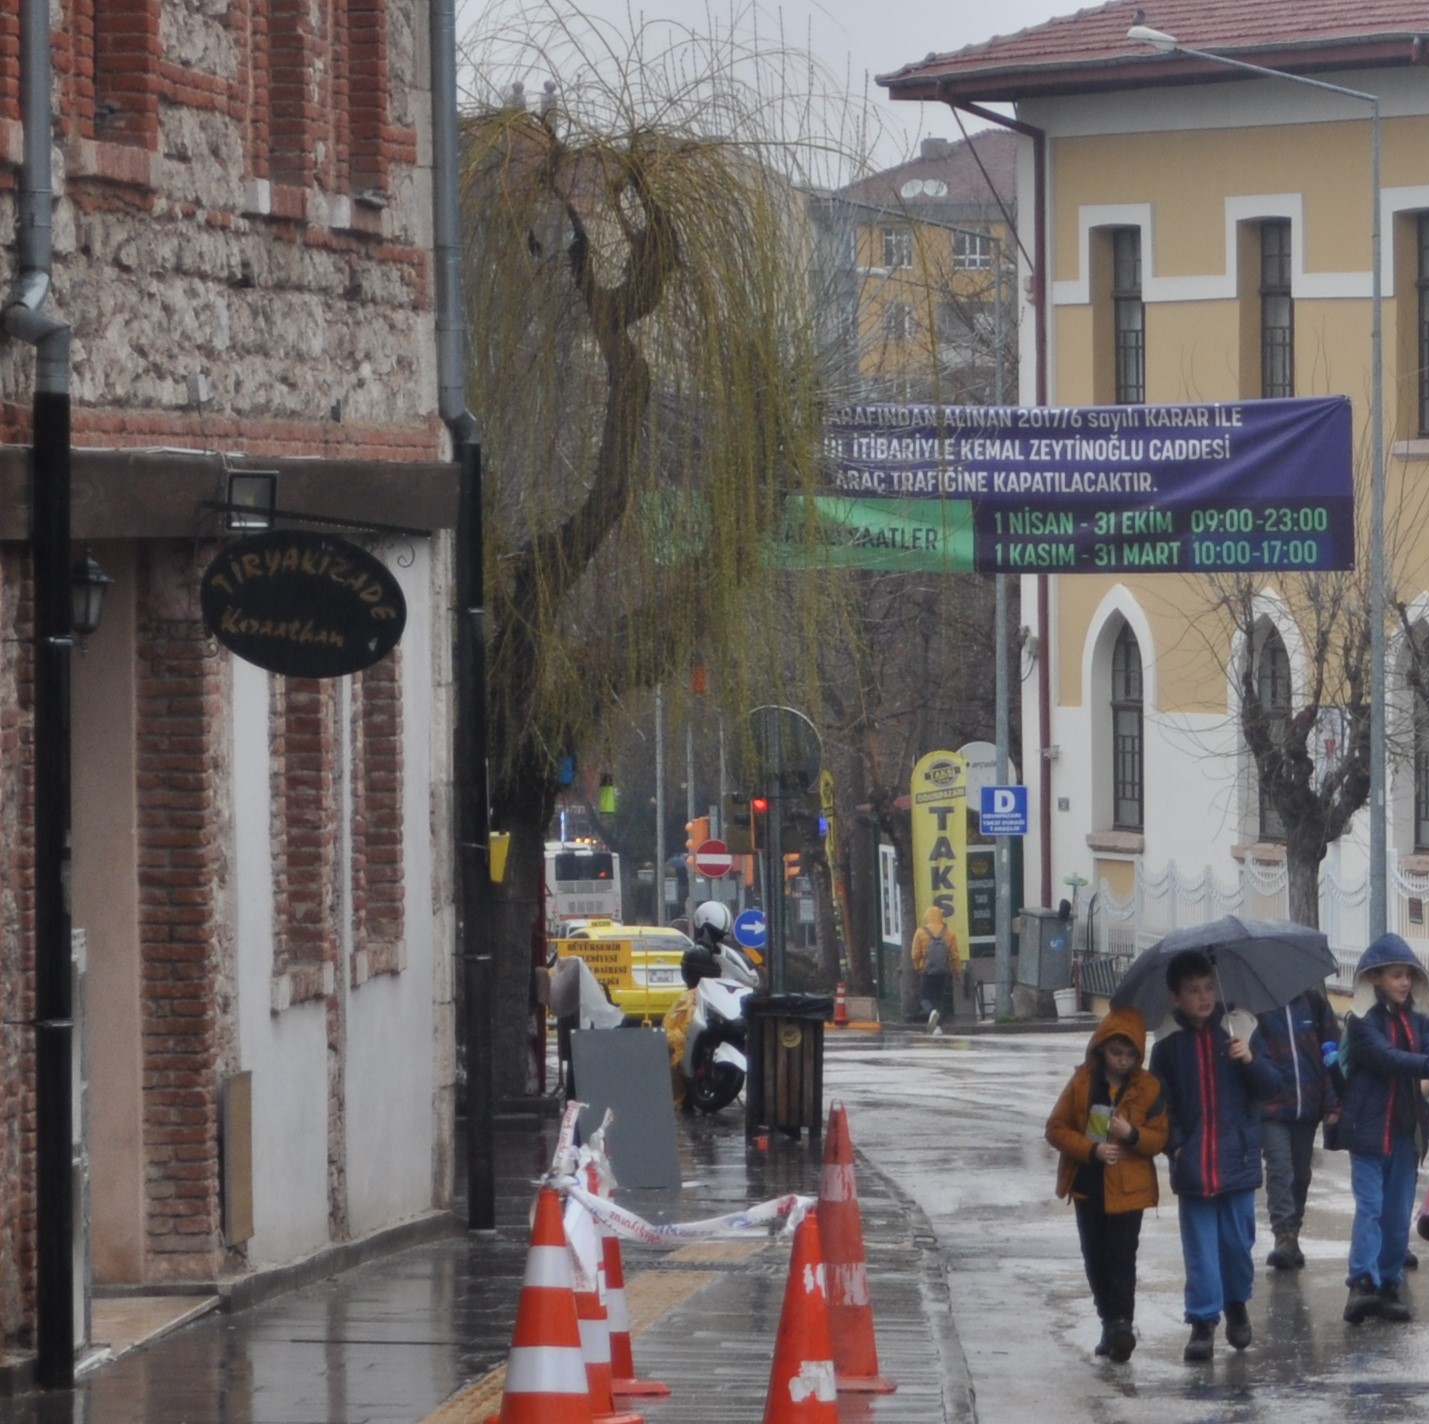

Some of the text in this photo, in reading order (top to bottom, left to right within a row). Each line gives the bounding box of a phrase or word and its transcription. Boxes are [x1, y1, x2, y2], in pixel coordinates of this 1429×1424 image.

[944, 407, 1012, 428] ALINAN
[1017, 408, 1082, 429] 2017/6
[1088, 408, 1138, 432] sayılı
[1146, 407, 1209, 428] KARAR
[1214, 402, 1243, 427] İLE
[961, 439, 1024, 460] KEMAL
[1029, 434, 1143, 461] ZEYTİNOĞLU
[1149, 434, 1231, 461] CADDESİ
[836, 466, 1158, 495] ARAÇ TRAFİĞİNE KAPATILACAKTIR.
[994, 513, 1002, 534] 1
[1009, 506, 1073, 535] NİSAN
[1094, 511, 1116, 535] 31
[1122, 505, 1173, 534] EKİM
[994, 543, 1002, 565] 1
[1009, 543, 1075, 567] KASIM
[1094, 543, 1116, 566] 31
[1123, 541, 1181, 566] MART
[994, 790, 1016, 813] D
